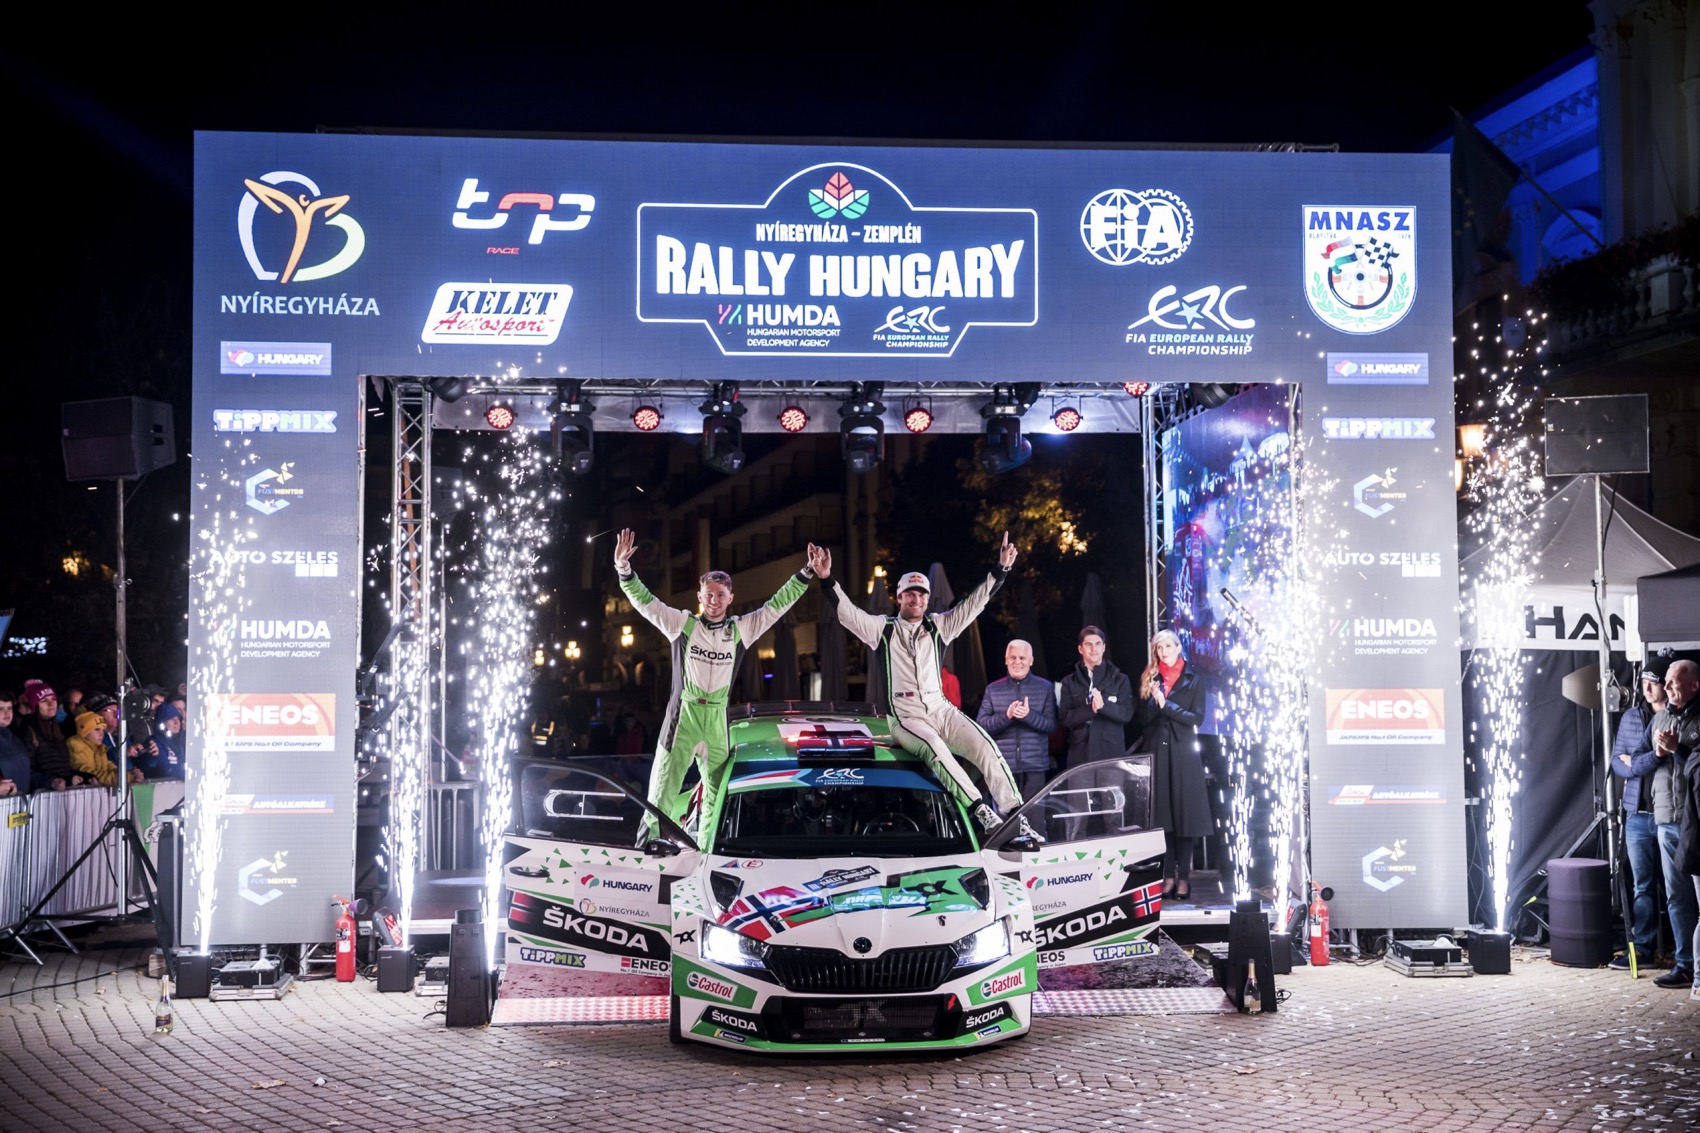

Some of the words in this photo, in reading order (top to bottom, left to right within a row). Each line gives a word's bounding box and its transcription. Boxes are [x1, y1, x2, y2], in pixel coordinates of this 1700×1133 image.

[1309, 211, 1410, 231] MNASZ
[756, 220, 848, 243] NYÍREGYHÁZA
[863, 223, 922, 244] ZEMPLÉN
[656, 234, 795, 296] RALLY
[810, 240, 1024, 299] HUNGARY
[220, 291, 380, 316] NYÍREGYHÁZA
[445, 290, 558, 315] KELET
[433, 311, 555, 336] Autosport
[747, 304, 841, 326] HUMDA
[747, 339, 798, 347] DEVELOPMENT
[799, 339, 830, 347] AGENCY
[1125, 333, 1146, 343] FIA
[1149, 333, 1214, 344] EUROPEAN
[1216, 333, 1255, 344] RALLY
[257, 353, 324, 365] HUNGARY
[1147, 345, 1253, 355] CHAMPIONSHIP
[1360, 363, 1421, 374] HUNGARY
[241, 620, 331, 639] HUMDA
[1354, 618, 1437, 637] HUMDA
[241, 650, 290, 658] DEVELOPMENT
[690, 644, 733, 660] ŠKODA
[226, 704, 320, 725] ENEOS
[1341, 699, 1430, 719] ENEOS
[602, 879, 653, 893] HUNGARY
[1047, 872, 1093, 887] HUNGARY
[599, 906, 650, 918] NYÍREGYHÁZA
[1032, 901, 1067, 912] REGYHÁZA
[542, 905, 649, 952] ŠKODA
[698, 977, 733, 998] Castrol
[992, 972, 1023, 994] Castrol
[711, 1009, 758, 1032] ŠKODA
[966, 1006, 1005, 1029] ŠKODA
